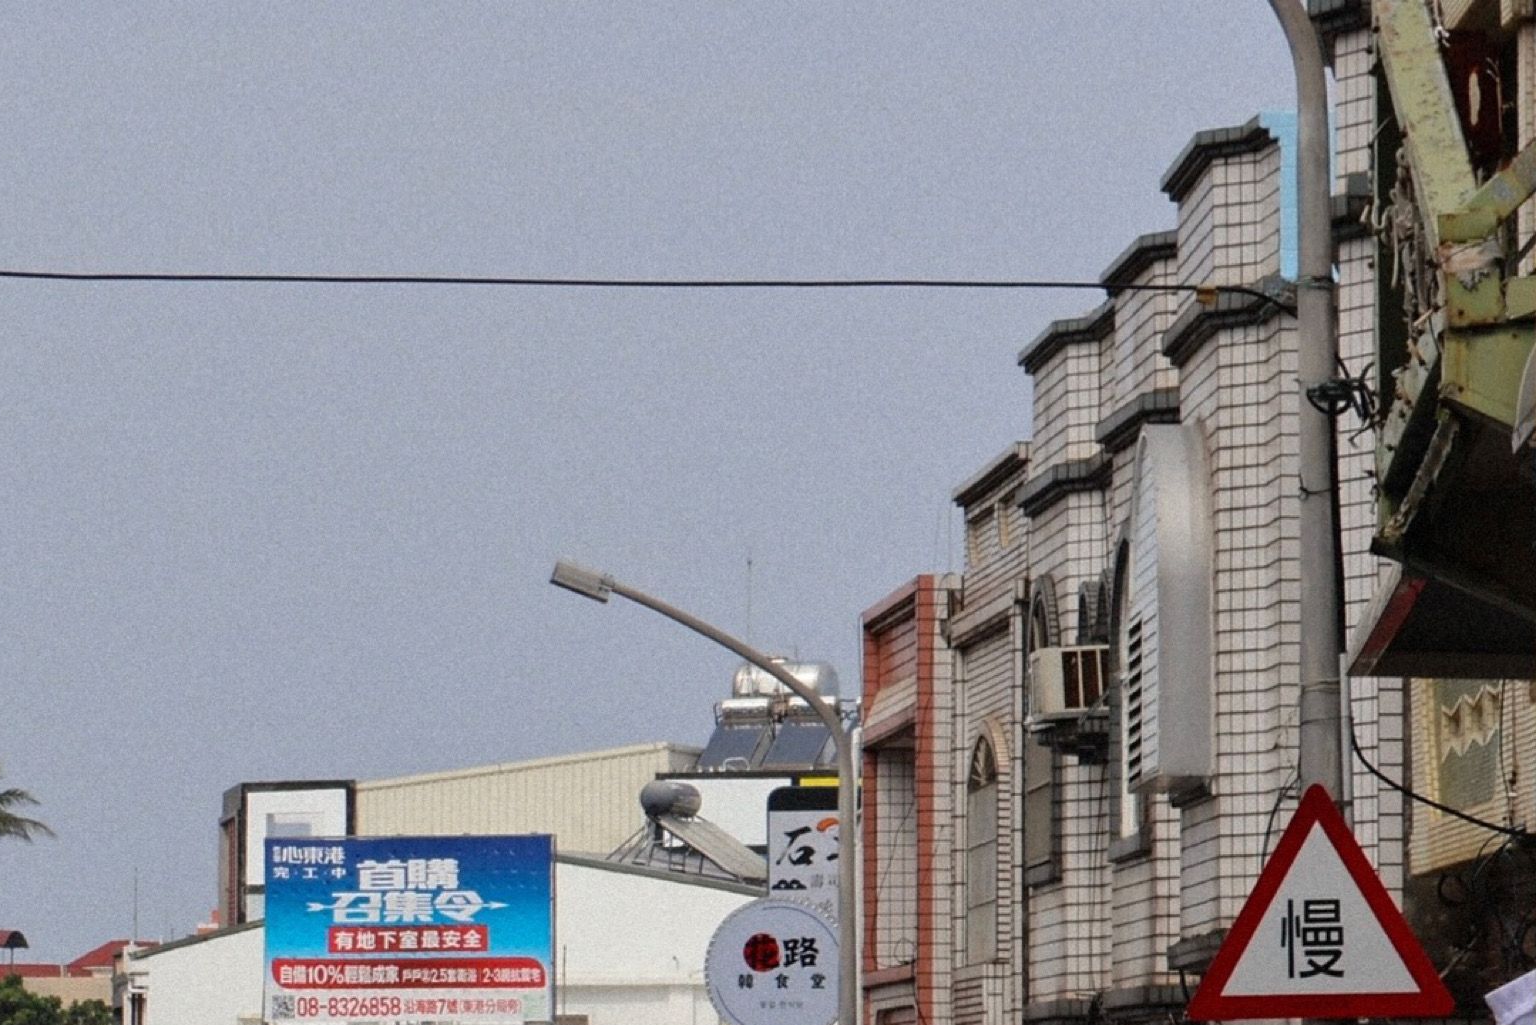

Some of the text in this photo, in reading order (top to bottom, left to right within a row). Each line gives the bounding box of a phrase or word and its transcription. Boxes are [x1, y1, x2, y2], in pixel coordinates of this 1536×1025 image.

[356, 858, 459, 890] 首購
[331, 889, 484, 923] 召集令
[334, 930, 482, 952] 有地下室最安全
[1280, 899, 1345, 979] 慢
[296, 996, 402, 1018] 08-8326858
